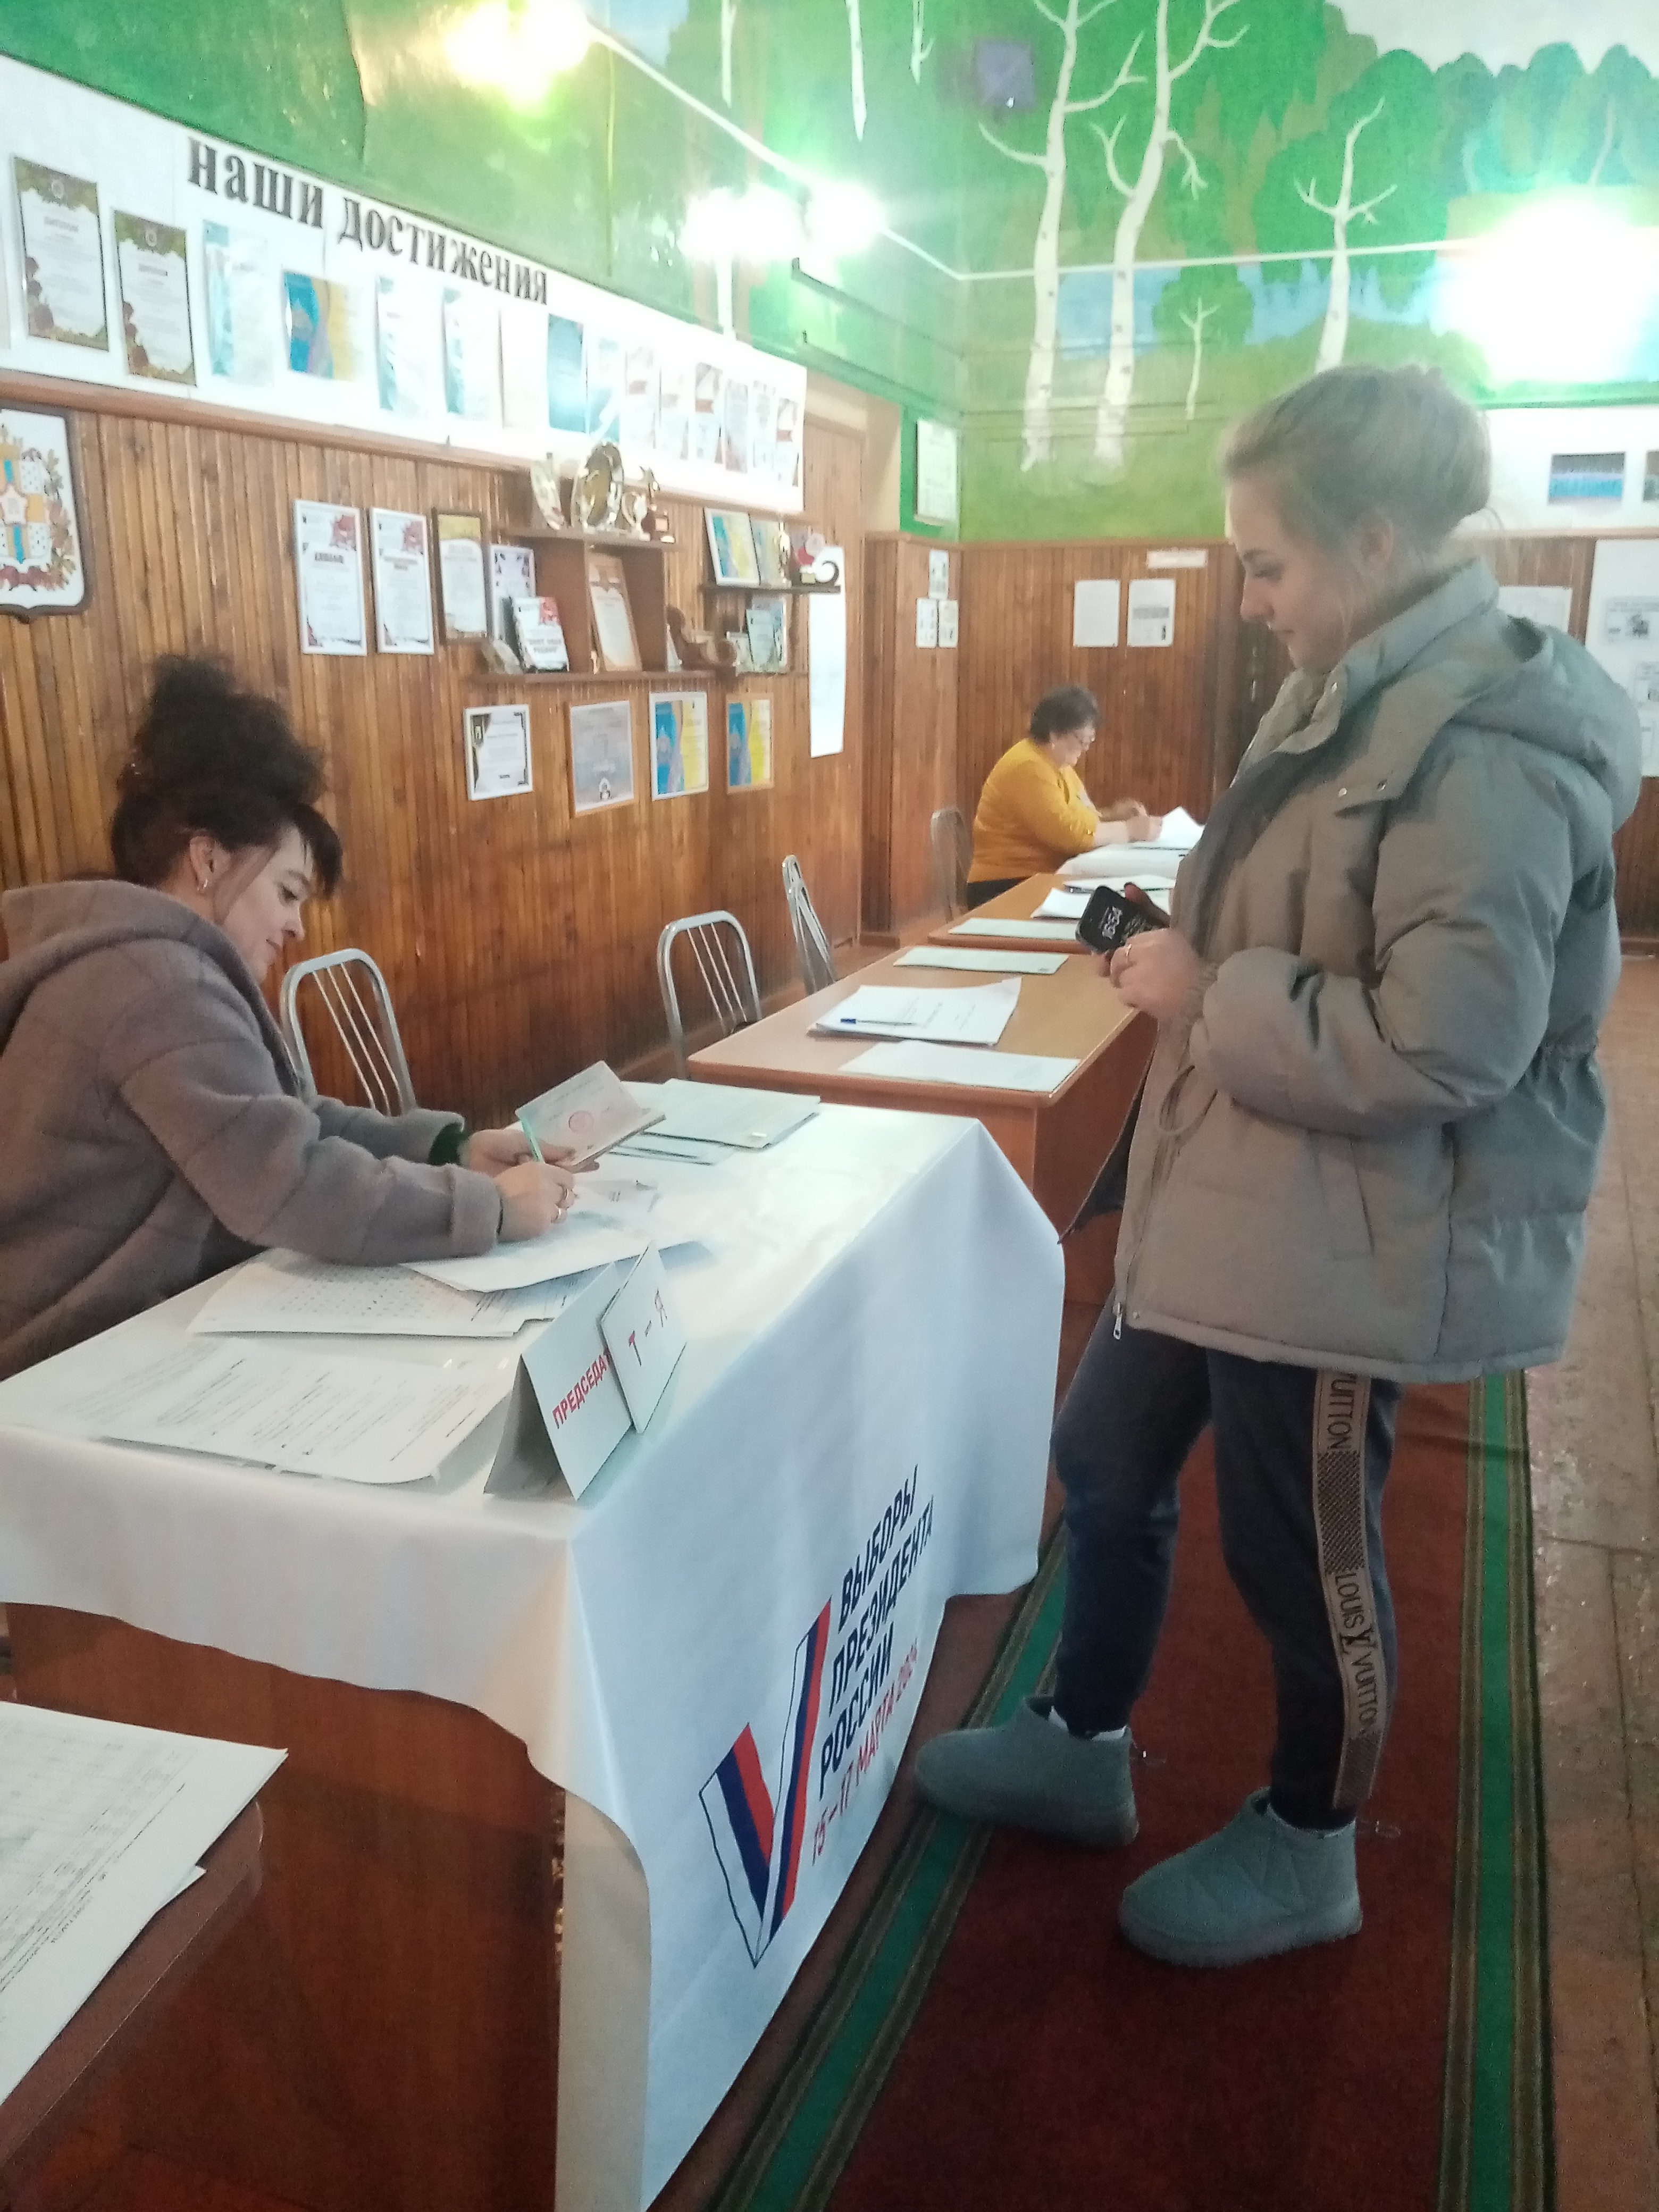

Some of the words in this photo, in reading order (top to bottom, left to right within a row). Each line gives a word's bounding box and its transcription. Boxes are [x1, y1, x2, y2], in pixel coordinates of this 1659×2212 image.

[338, 196, 548, 305] достижения
[829, 1494, 934, 1717] ПРЕЗИДЕНТА
[837, 1463, 918, 1634] ВЫБОРЫ
[819, 1621, 894, 1802] РОССИИ
[1335, 1572, 1365, 1629] LOUIS
[1351, 1650, 1378, 1731] VUITTO
